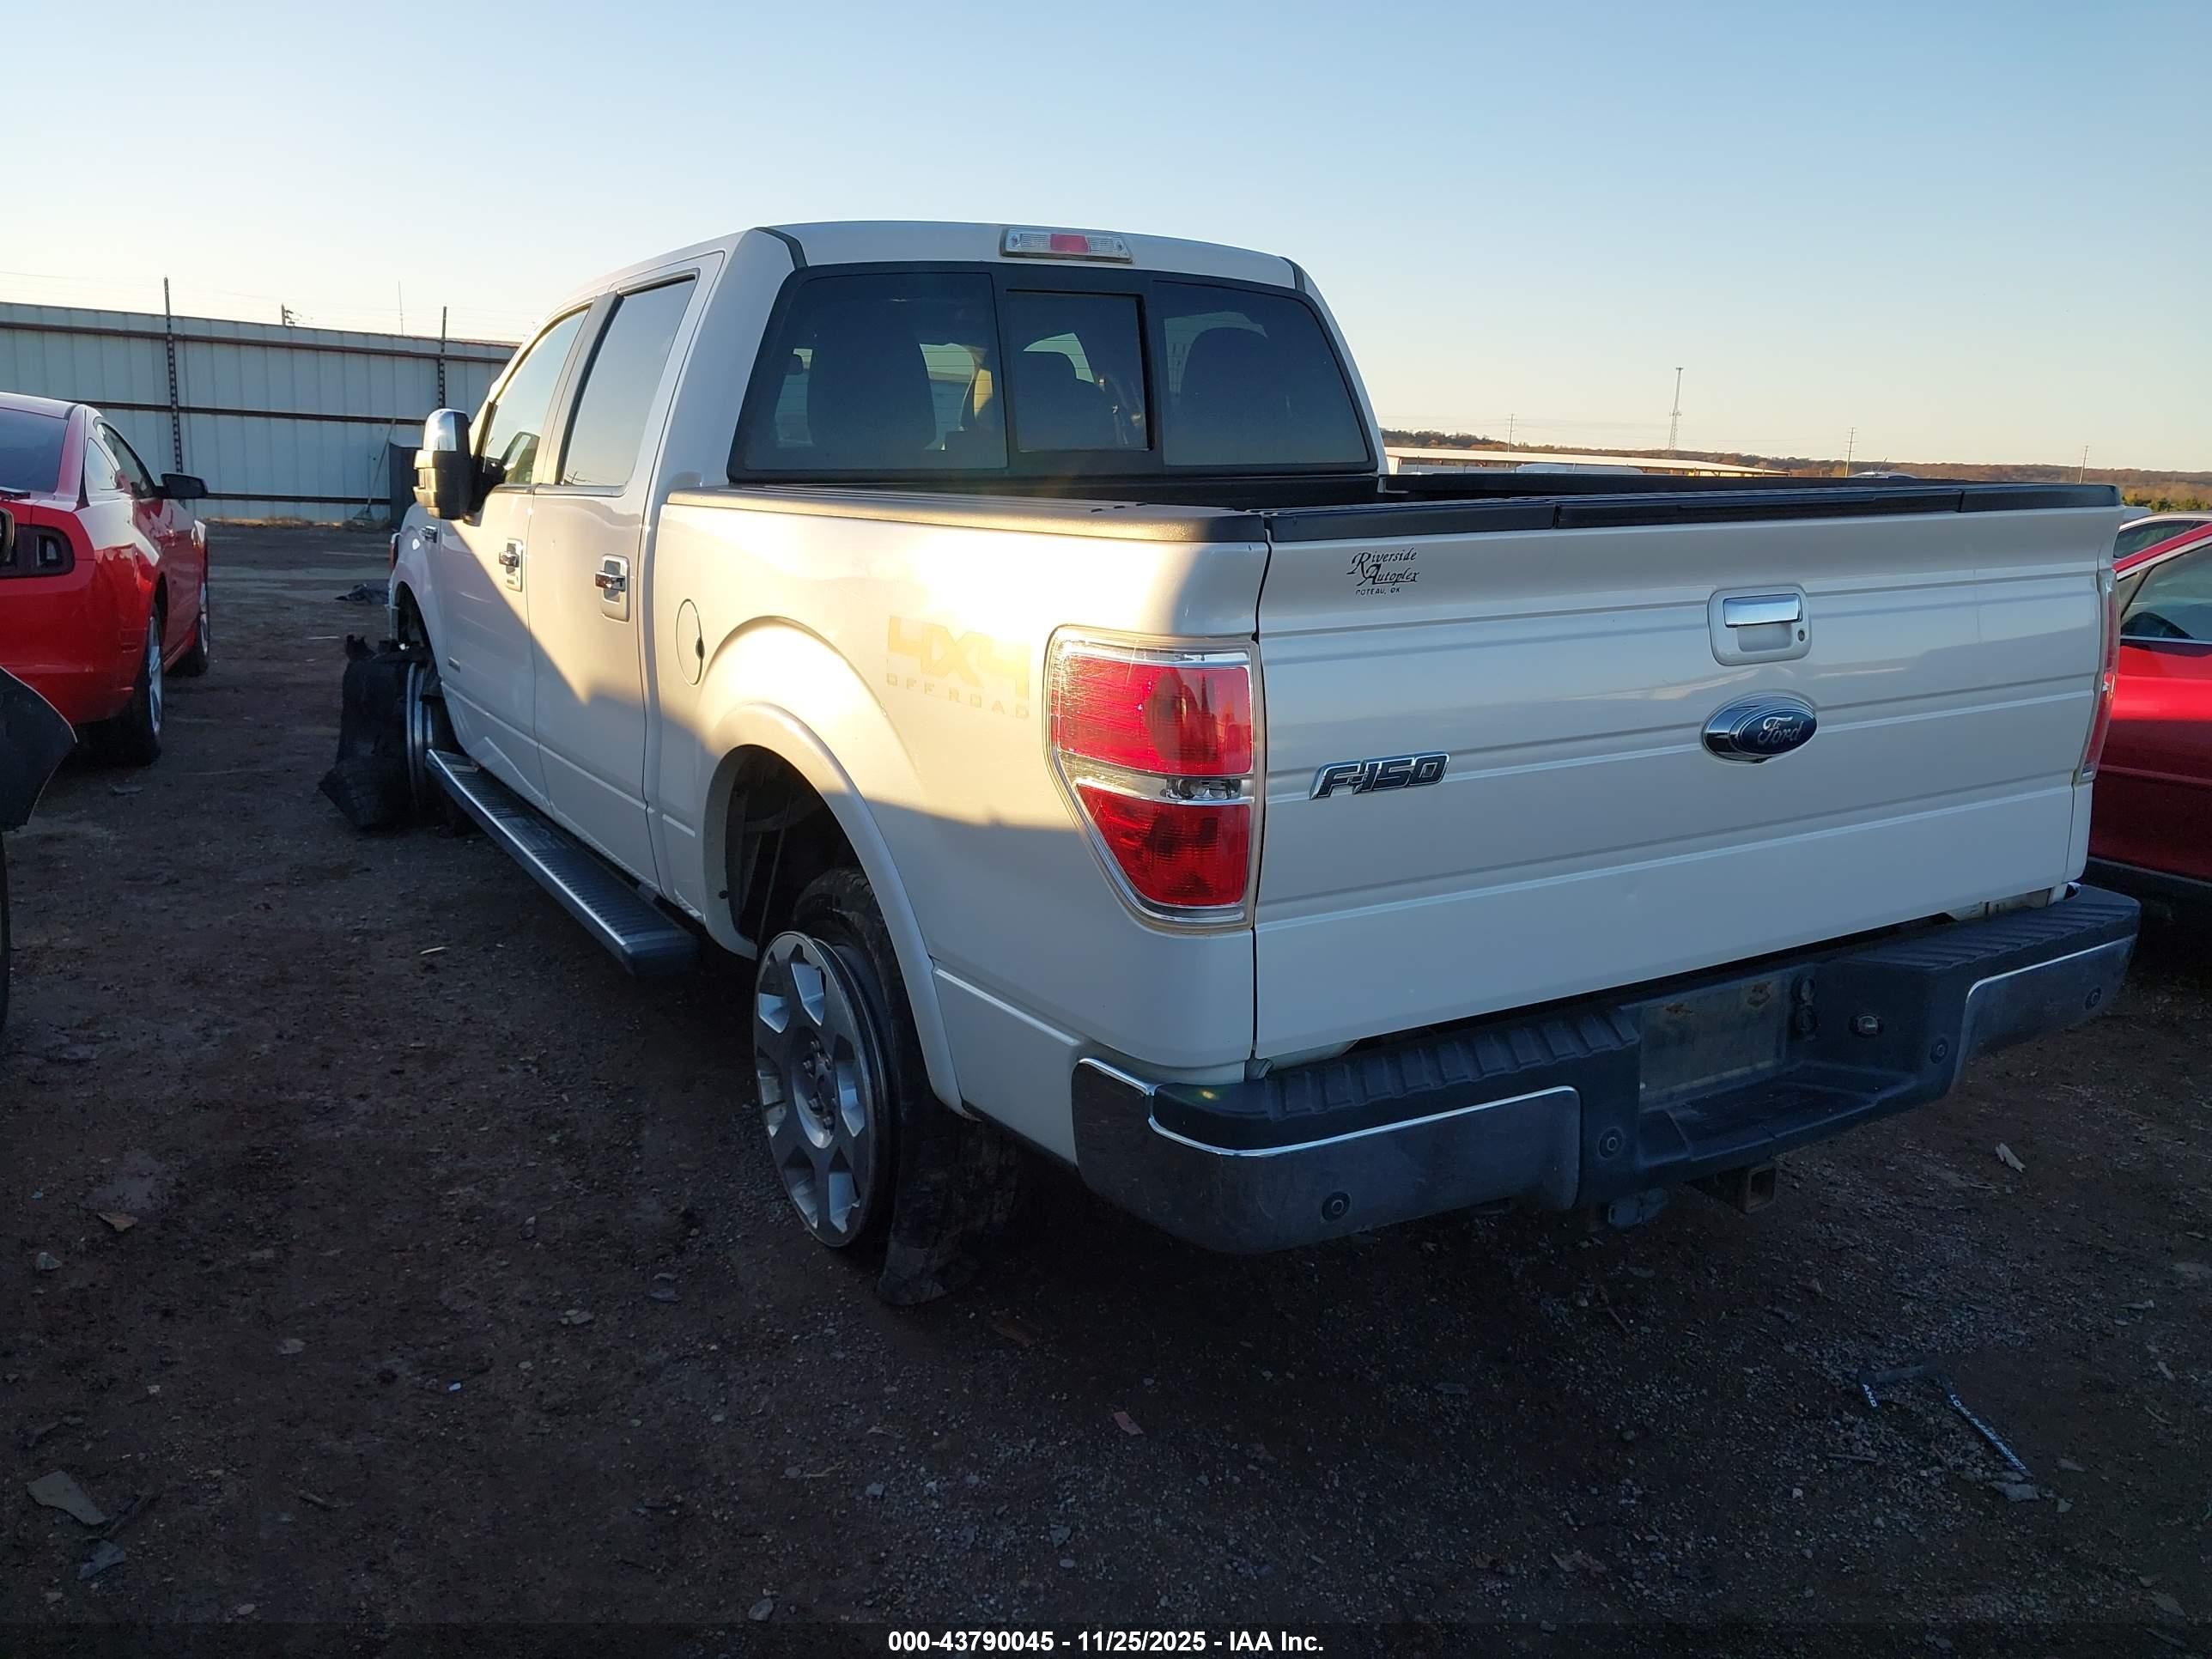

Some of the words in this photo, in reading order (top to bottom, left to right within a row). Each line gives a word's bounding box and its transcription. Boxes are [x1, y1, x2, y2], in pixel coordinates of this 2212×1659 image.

[1346, 547, 1418, 575] Riverside
[1357, 562, 1419, 586] Autoplex
[1757, 715, 1804, 744] Ford
[1310, 750, 1449, 800] F-150
